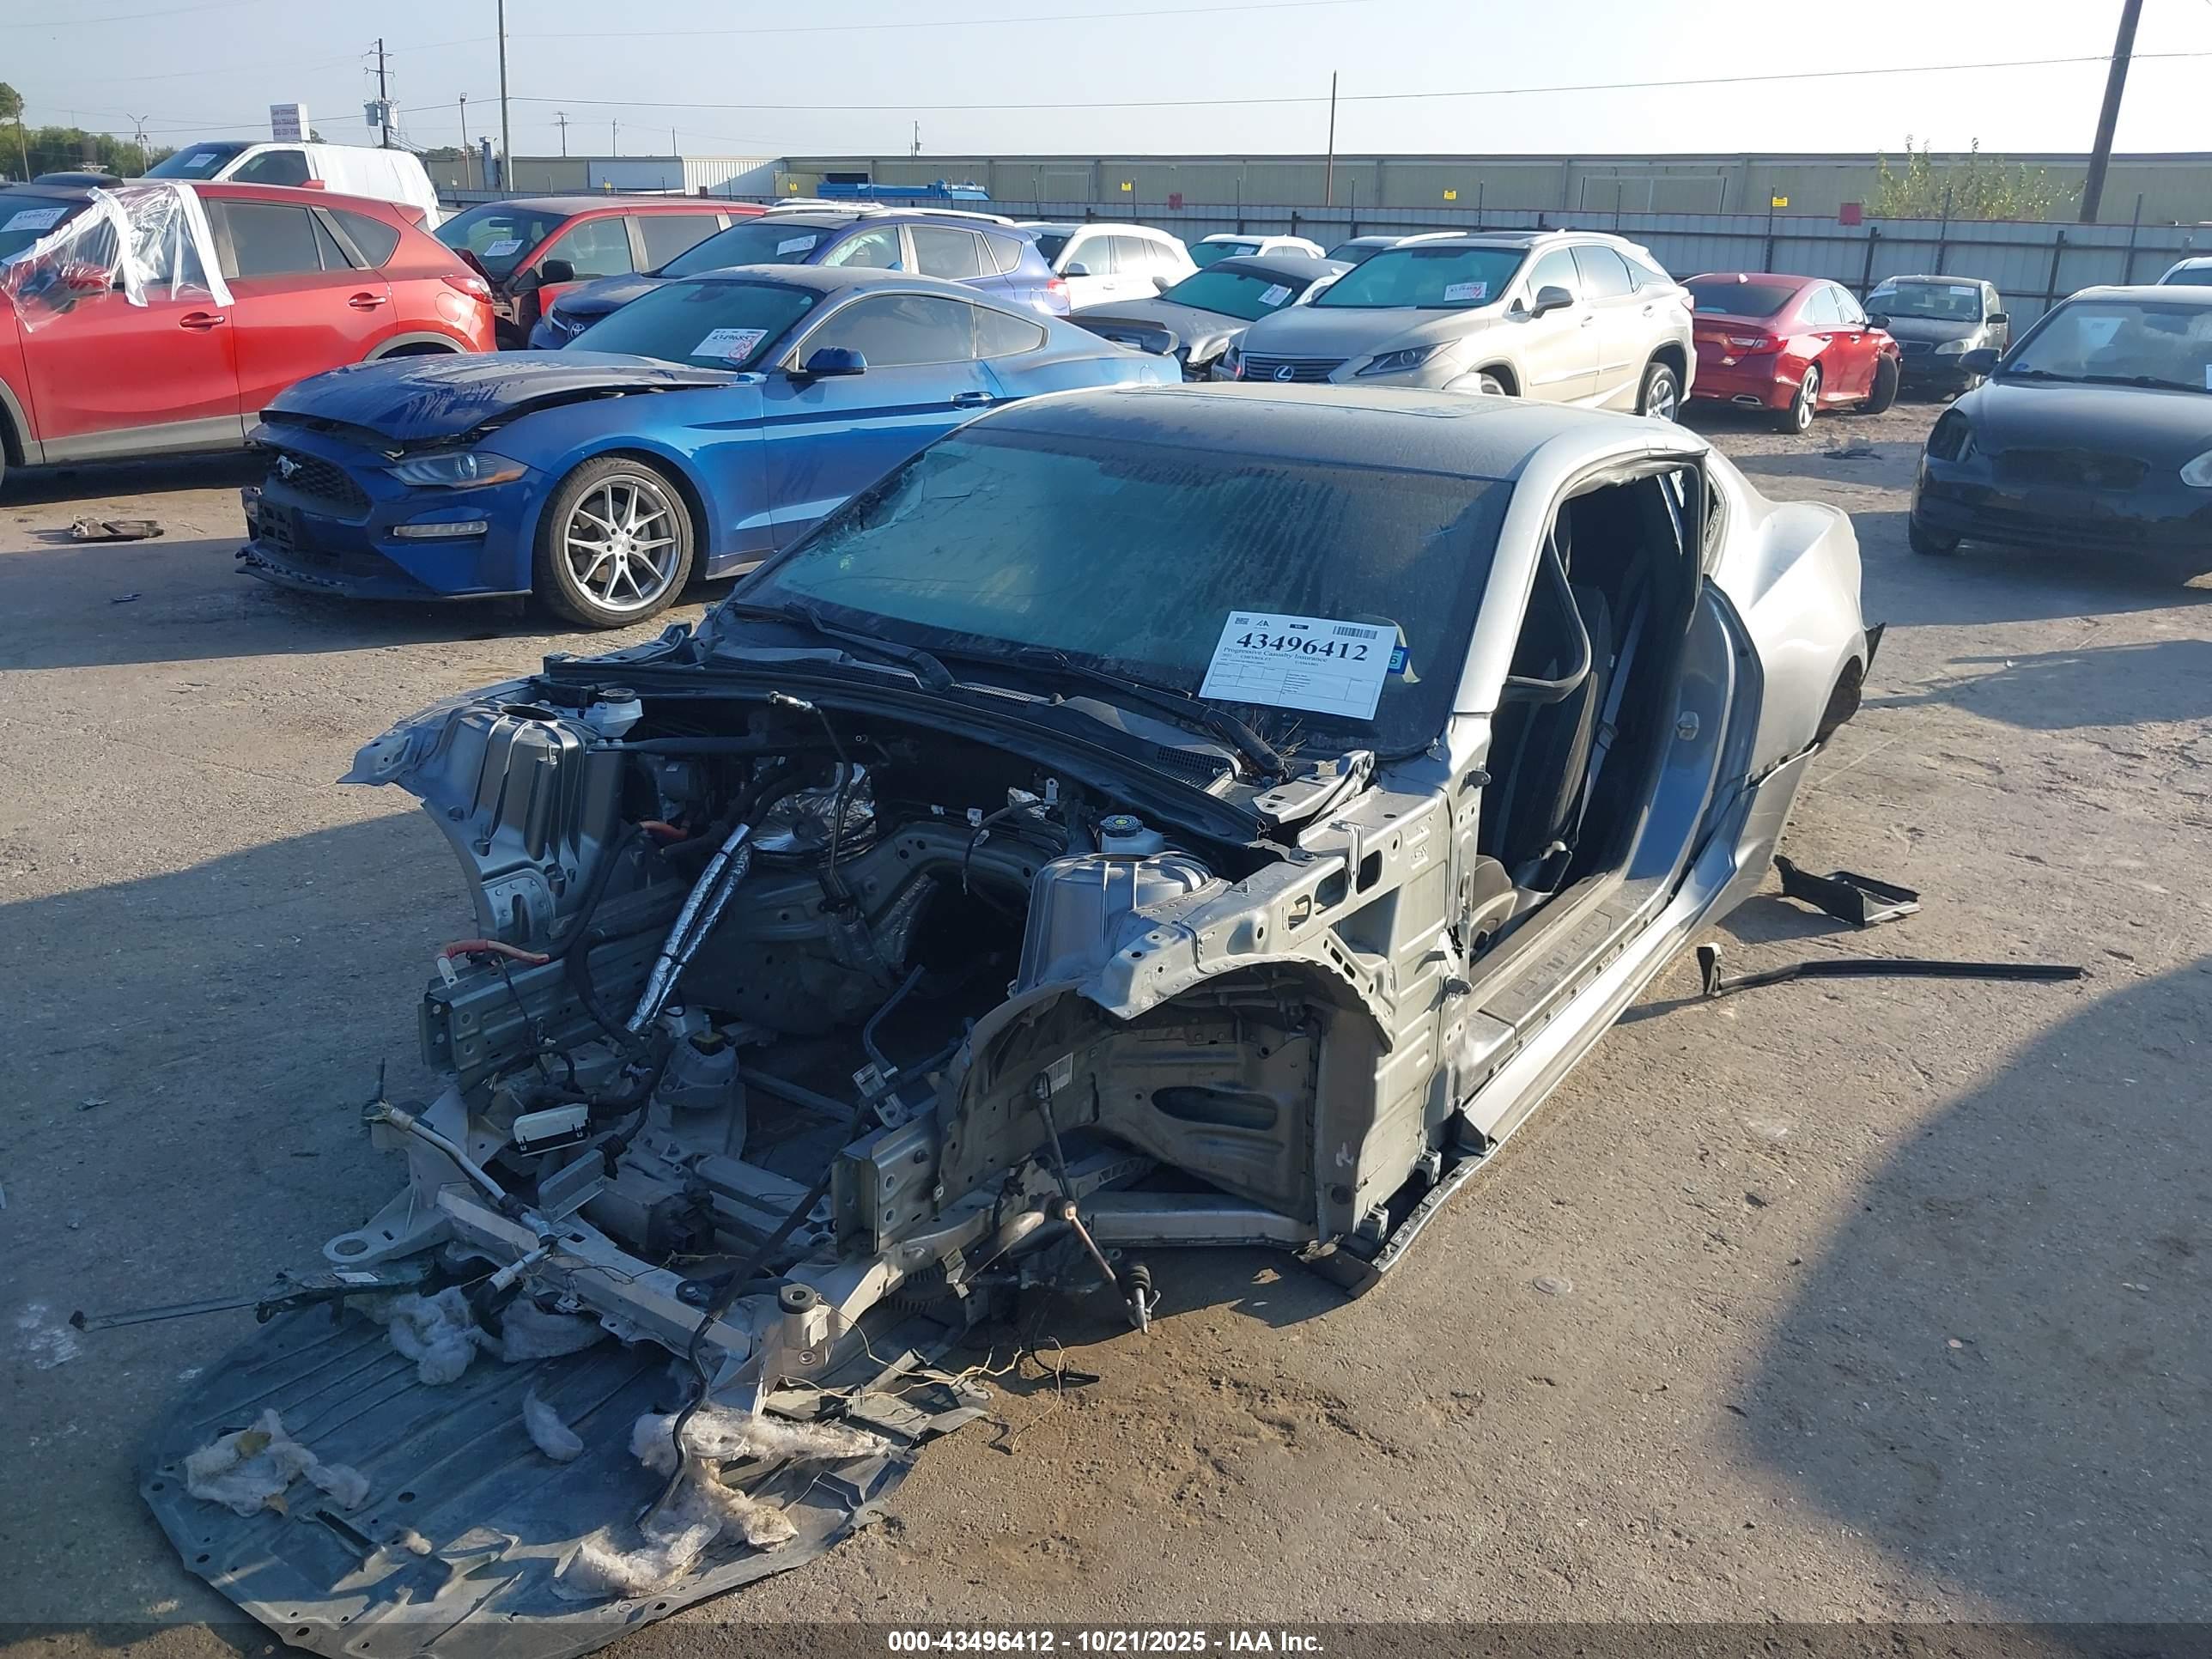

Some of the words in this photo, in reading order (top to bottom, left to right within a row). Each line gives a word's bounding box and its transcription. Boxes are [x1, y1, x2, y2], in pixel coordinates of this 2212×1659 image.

[1224, 647, 1263, 655] Progressive
[1263, 650, 1292, 659] Casualty
[1294, 653, 1328, 663] Insurance
[1237, 632, 1368, 662] 43496412
